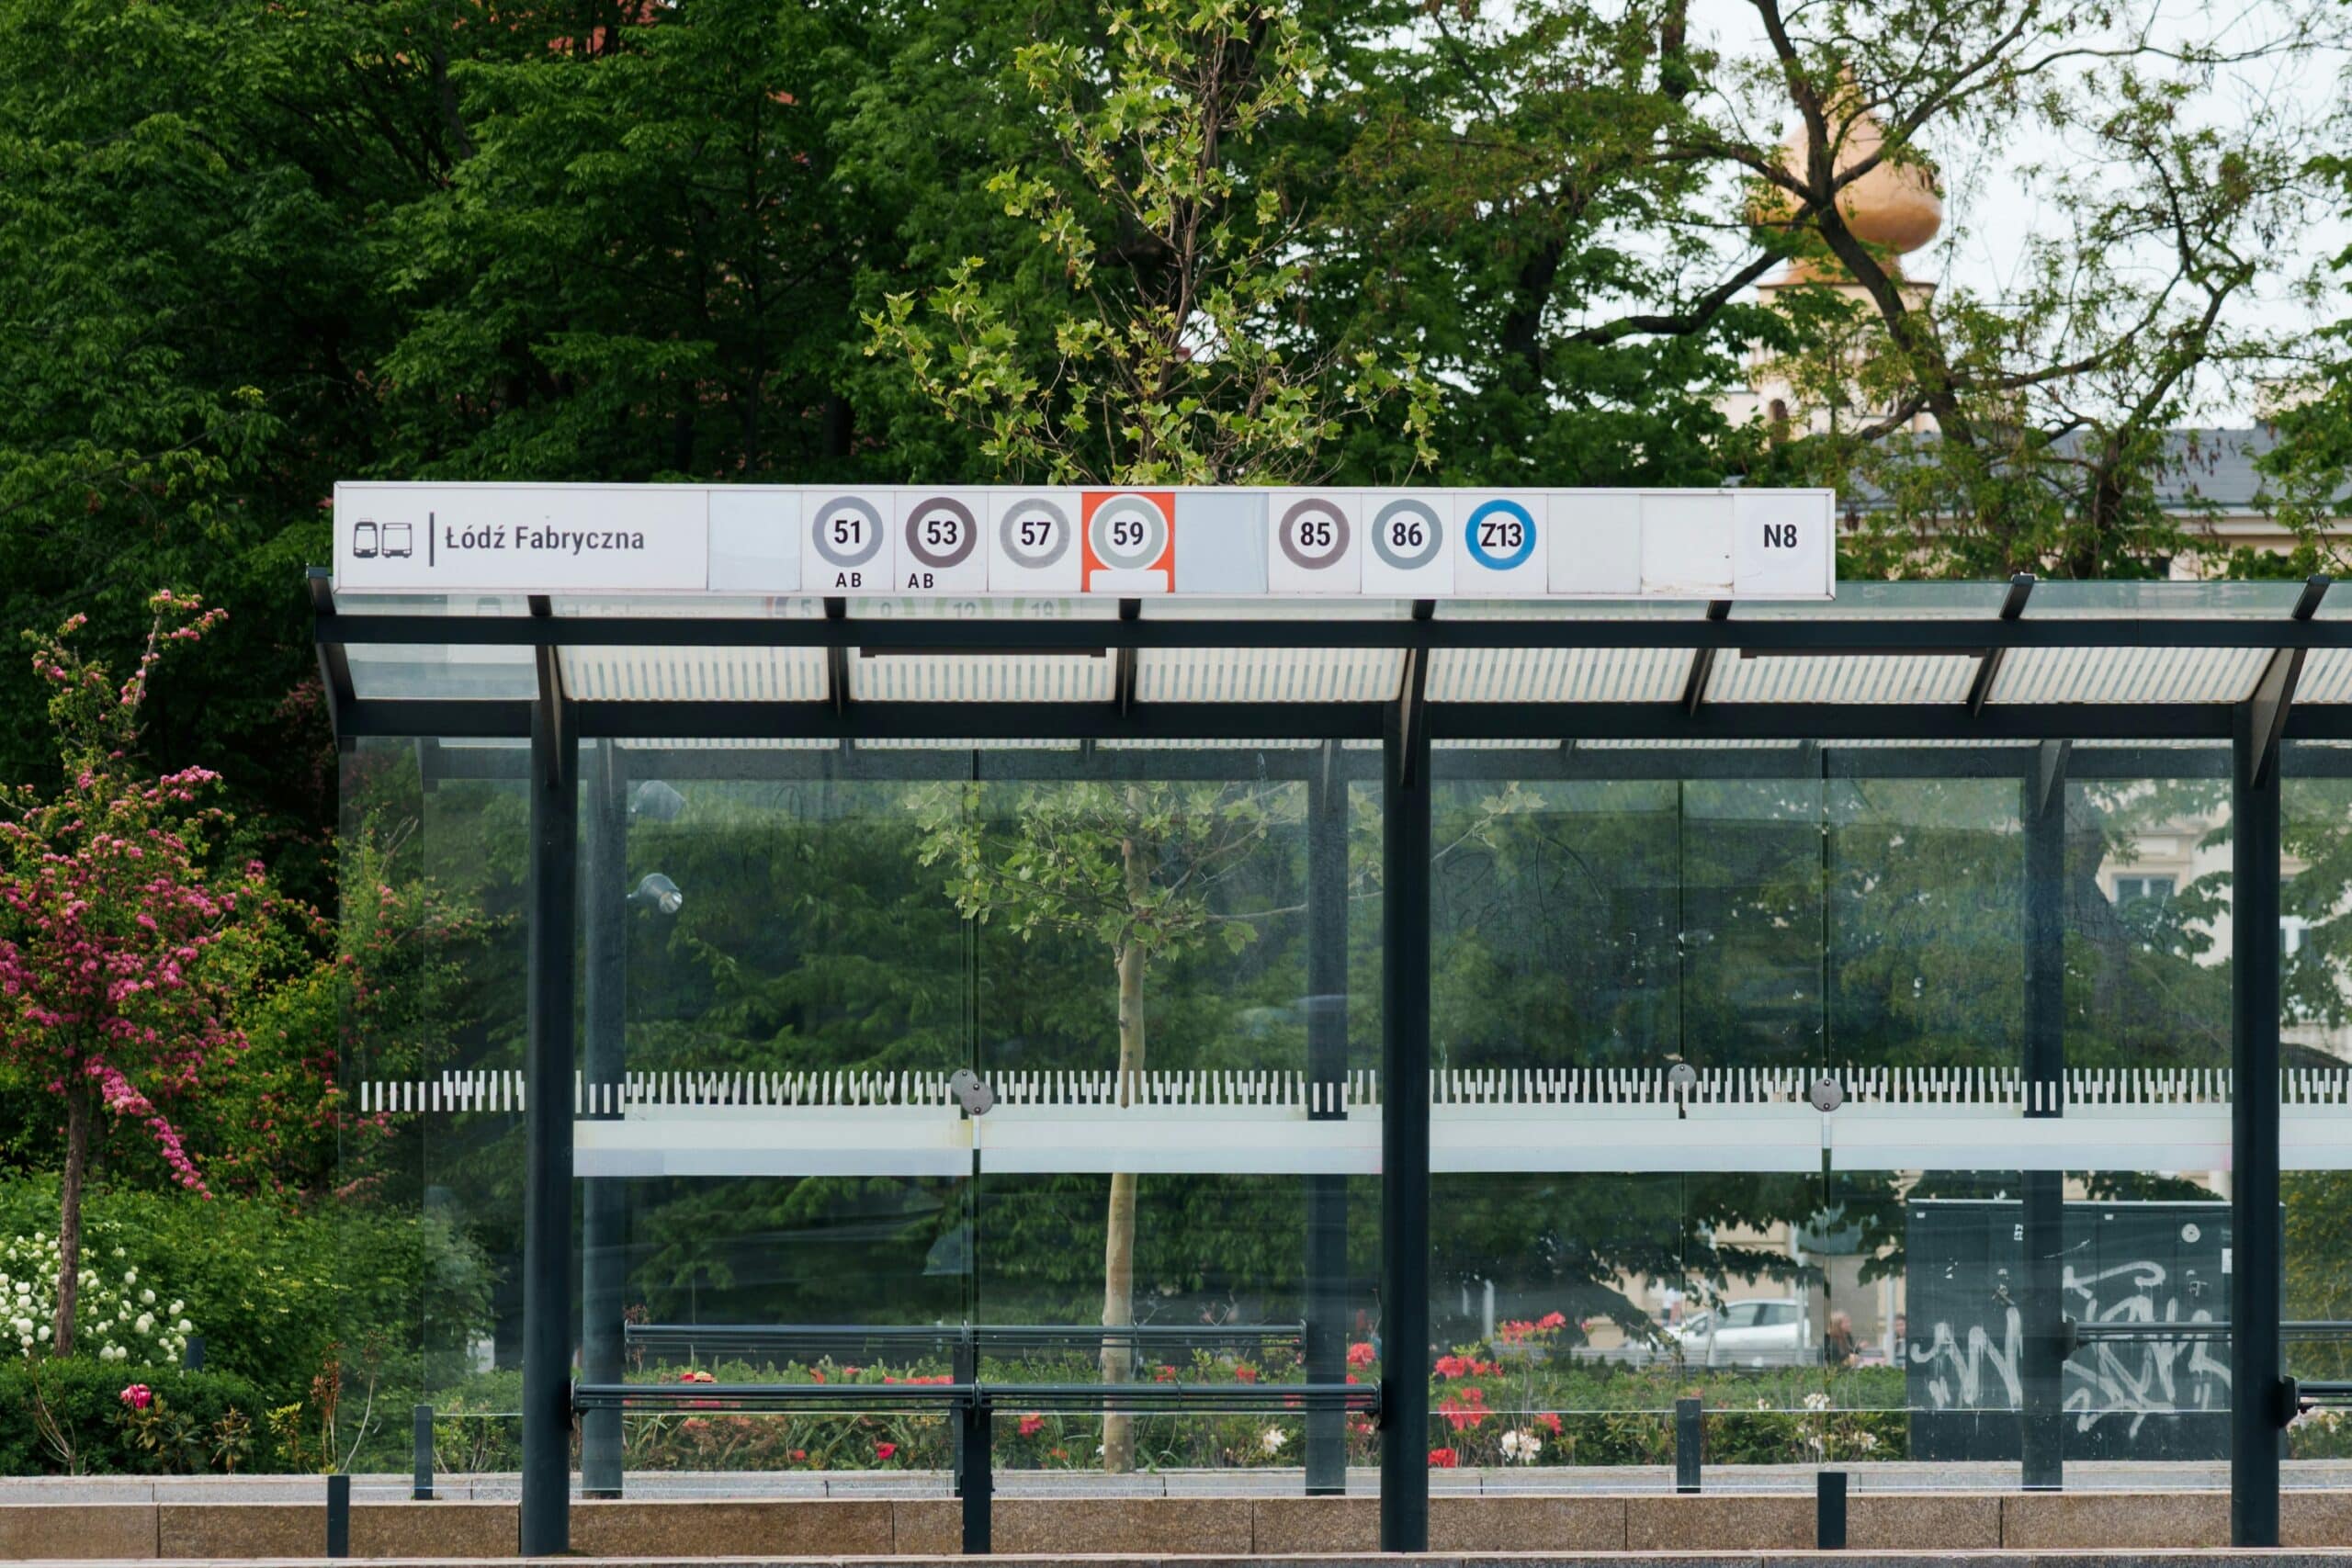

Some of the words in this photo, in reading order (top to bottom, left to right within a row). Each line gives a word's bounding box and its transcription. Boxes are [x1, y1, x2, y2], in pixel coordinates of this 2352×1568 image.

[446, 525, 506, 549] Łódź
[515, 525, 645, 556] Fabryczna
[833, 519, 861, 545] 51
[926, 520, 958, 546] 53
[1020, 521, 1052, 547] 57
[1113, 521, 1145, 547] 59
[1299, 521, 1332, 547] 85
[1391, 522, 1424, 547] 86
[1479, 522, 1523, 548] Z13
[1763, 524, 1798, 549] N8
